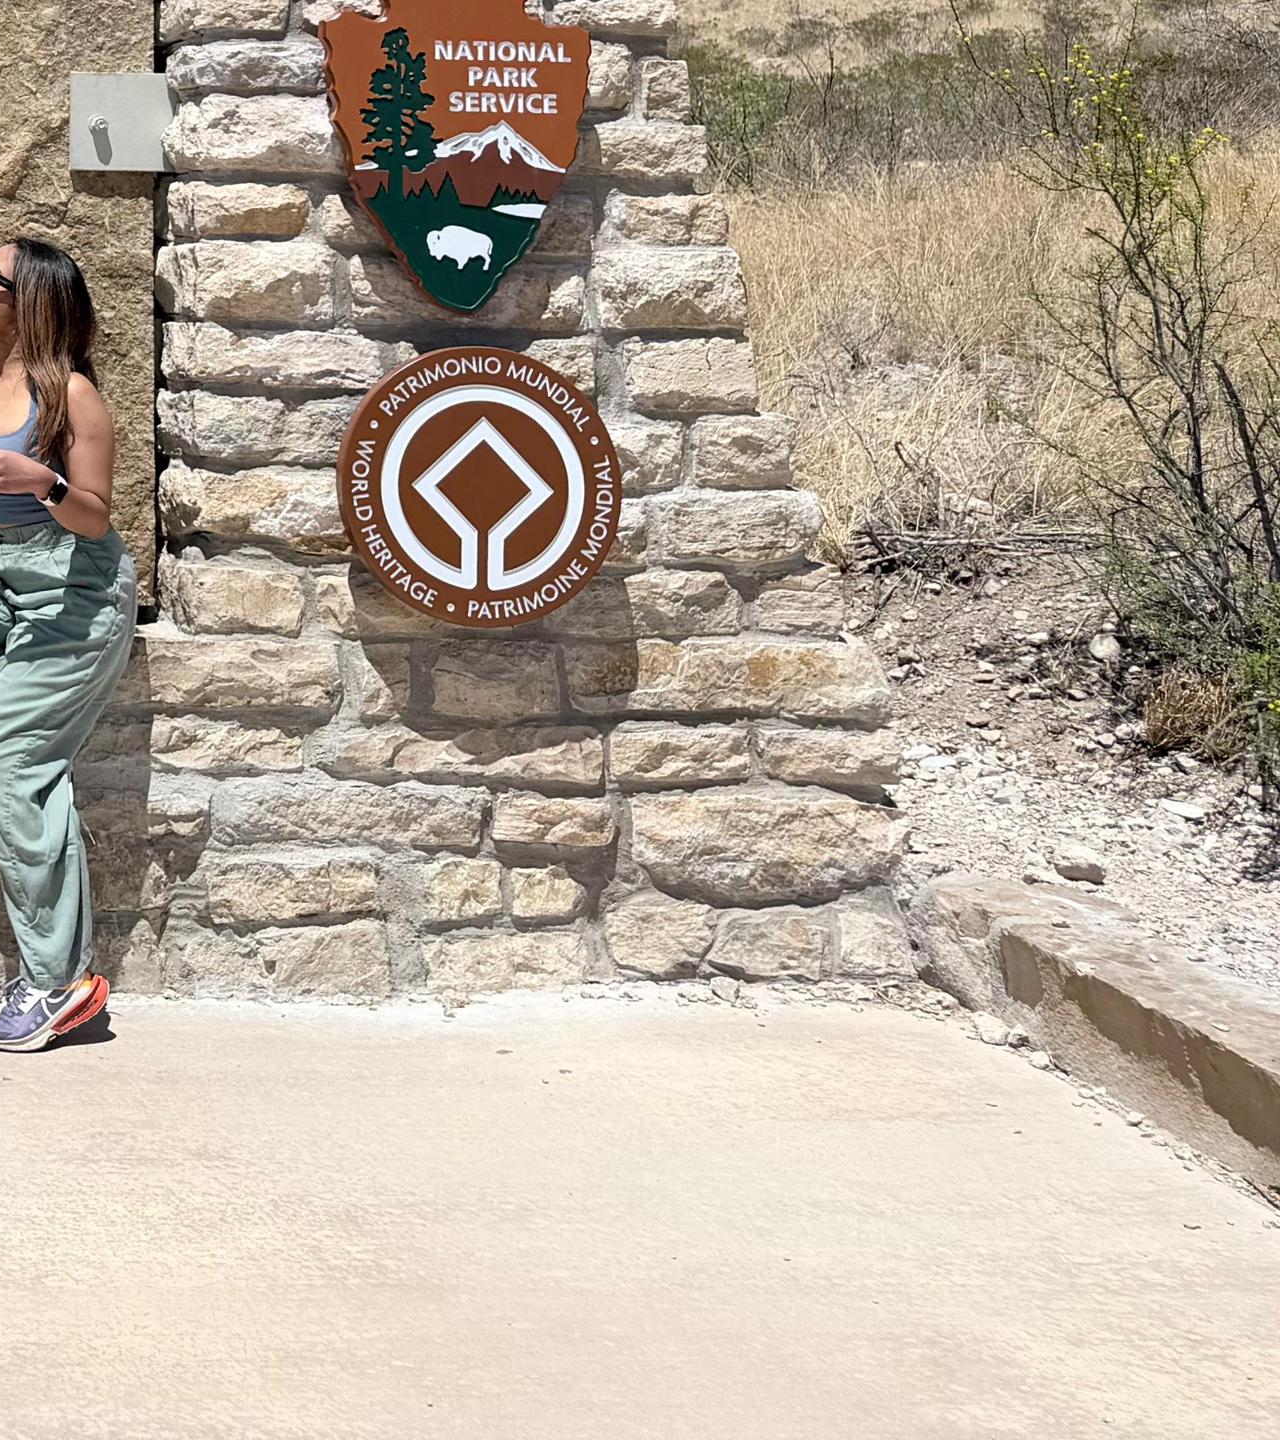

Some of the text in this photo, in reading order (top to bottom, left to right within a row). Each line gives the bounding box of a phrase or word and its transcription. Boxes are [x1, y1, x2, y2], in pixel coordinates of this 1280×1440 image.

[434, 40, 571, 63] NATIONAL
[467, 67, 538, 88] PARK
[448, 91, 558, 114] SERVICE
[379, 356, 590, 432] PATRIMONIO MUNDIAL
[351, 439, 438, 608] WORLD HERITAGE
[467, 454, 613, 619] PATRIMOINE MONDIAL
